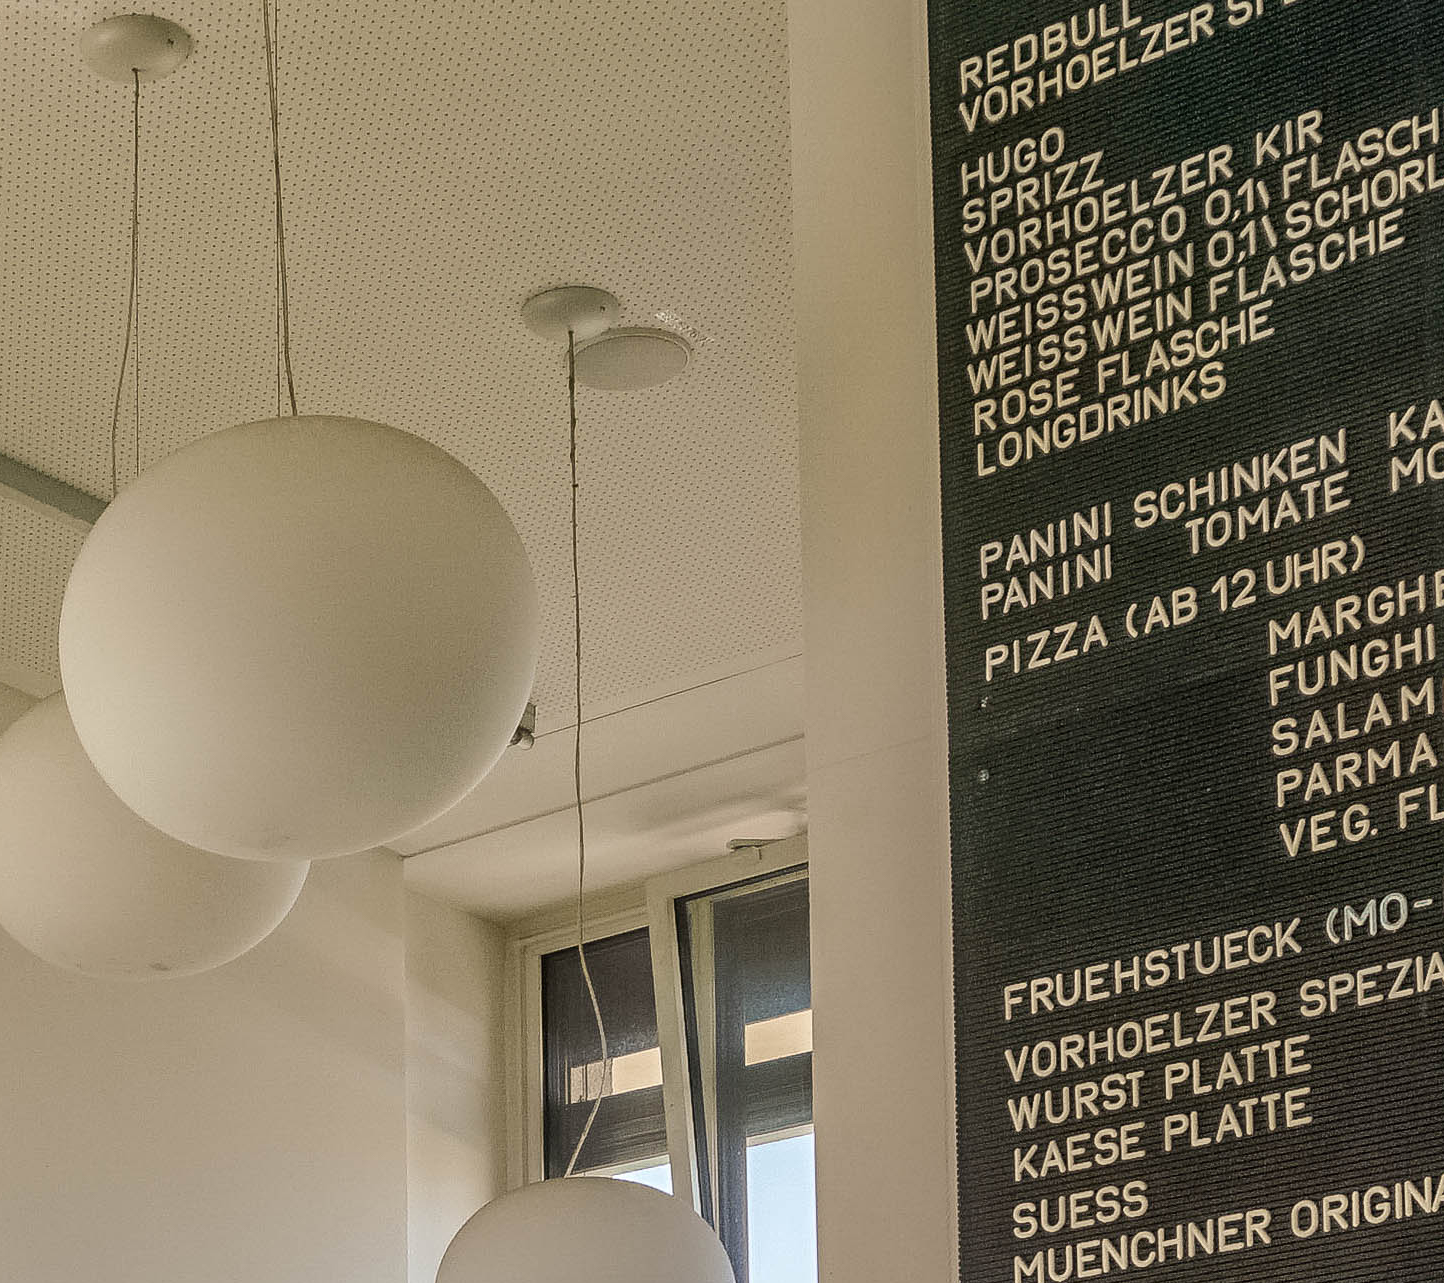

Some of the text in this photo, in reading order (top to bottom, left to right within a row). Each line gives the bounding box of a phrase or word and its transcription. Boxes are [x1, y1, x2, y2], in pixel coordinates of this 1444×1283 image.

[958, 2, 1215, 133] VORHOELZER
[959, 0, 1142, 96] REDBULL
[960, 126, 1065, 196] HUGO
[962, 150, 1105, 235] SPRIZZ
[963, 109, 1323, 273] VORHOELZER KIR
[965, 242, 1194, 355] WEISSWEIN
[966, 286, 1192, 395] WEISSWEIN
[1208, 208, 1405, 313] FLASCHE
[970, 204, 1187, 315] PROSECCO
[973, 367, 1081, 436] ROSE
[1097, 298, 1275, 394] FLASCHE
[976, 361, 1227, 478] LONGDRINKS
[979, 501, 1112, 580] PANINI
[1133, 428, 1346, 529] SCHINKEN
[980, 544, 1112, 621] PANINI
[1184, 470, 1351, 555] TOMATE
[984, 534, 1365, 683] PIZZA (AB 12 UHR)
[1268, 623, 1436, 707] FUNGHI
[1276, 732, 1438, 809] PARMA
[1279, 803, 1378, 858] VEG.
[1003, 917, 1302, 1022] FRUEHSTUECK
[1003, 990, 1277, 1083] VORHOELZER
[1006, 1070, 1145, 1133] WURST
[1164, 1034, 1312, 1101] PLATTE
[1013, 1121, 1146, 1183] KAESE
[1163, 1086, 1313, 1153] PLATTE
[1012, 1180, 1149, 1240] SUESS
